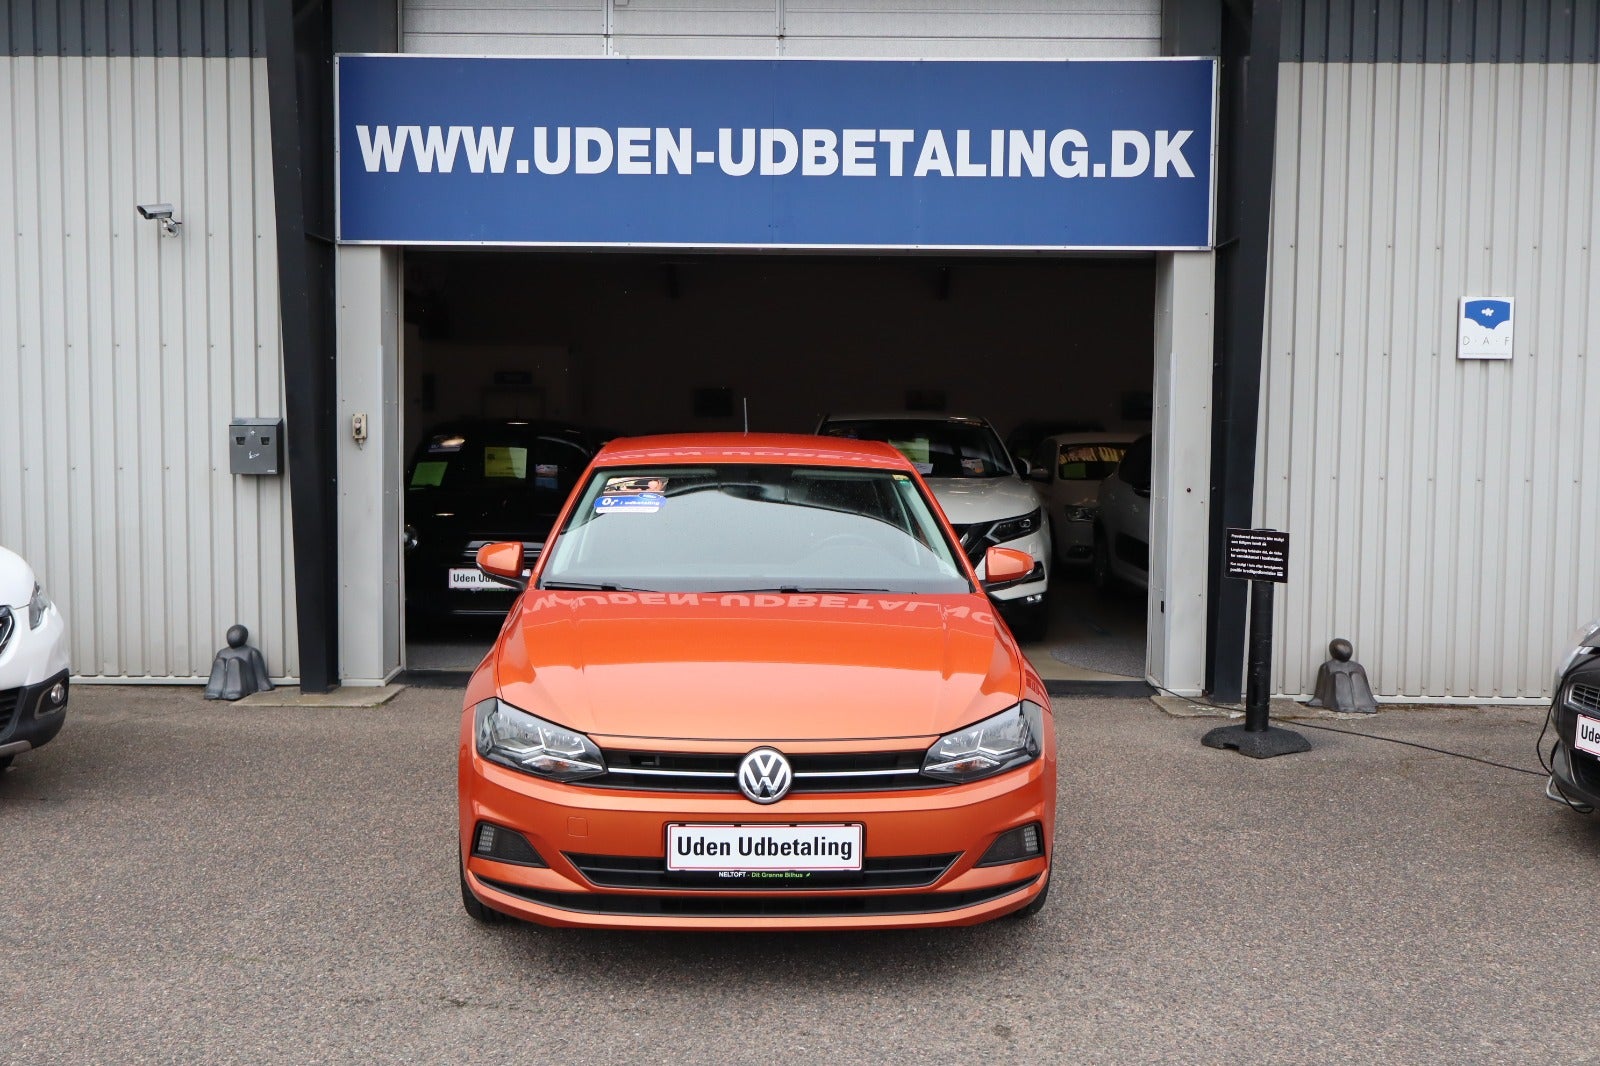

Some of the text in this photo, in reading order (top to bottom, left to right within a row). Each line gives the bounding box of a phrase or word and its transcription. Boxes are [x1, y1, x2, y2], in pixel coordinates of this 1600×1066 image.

[356, 125, 1195, 178] WWW.UDEN-UDBETALING.DK
[453, 574, 476, 583] Uden
[677, 836, 852, 860] Uden Udbetaling
